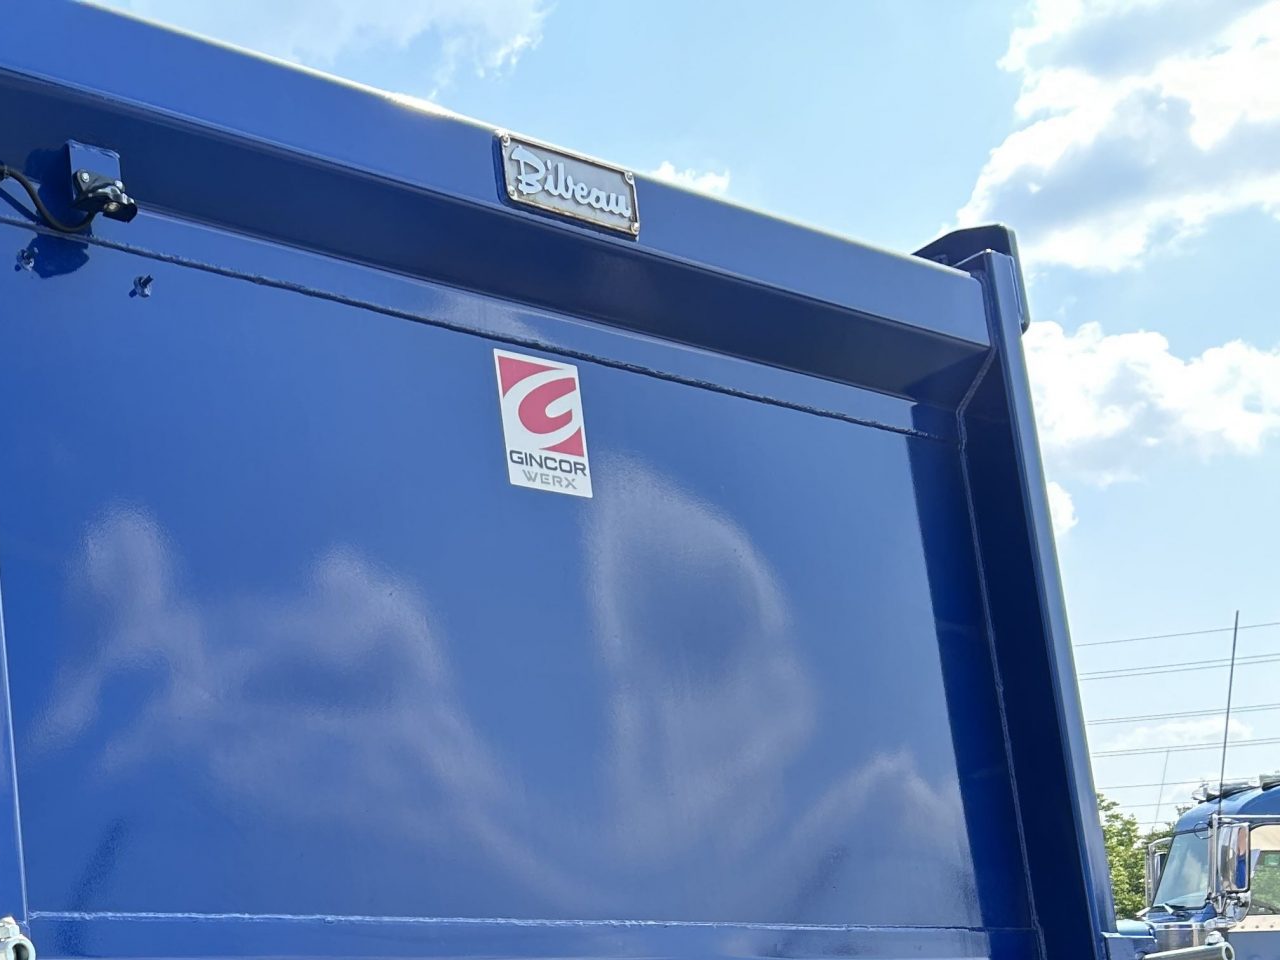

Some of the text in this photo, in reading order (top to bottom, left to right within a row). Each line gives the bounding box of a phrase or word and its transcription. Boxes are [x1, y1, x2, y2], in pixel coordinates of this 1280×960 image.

[510, 145, 632, 218] Bibeau
[509, 449, 587, 477] GINCOR
[522, 469, 578, 490] WERX
